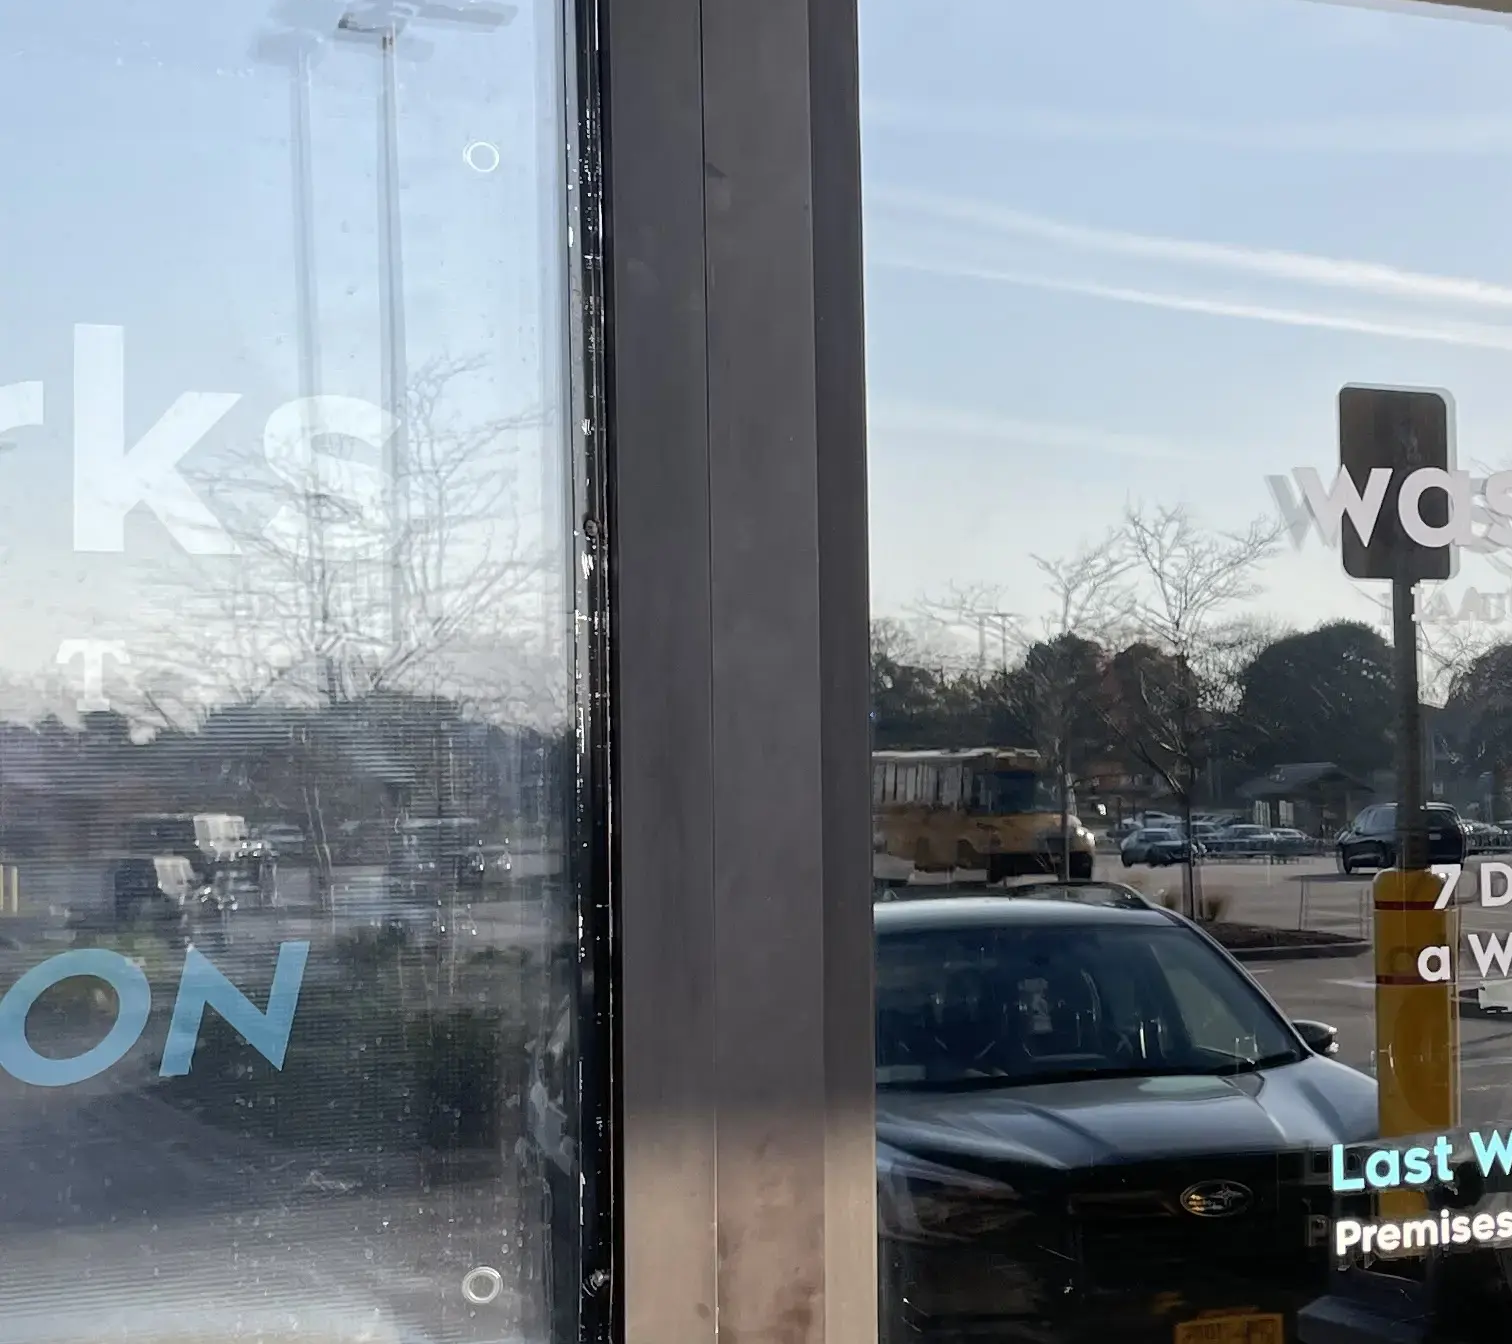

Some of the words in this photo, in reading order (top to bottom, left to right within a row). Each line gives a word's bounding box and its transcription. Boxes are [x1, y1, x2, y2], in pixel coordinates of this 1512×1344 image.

[1431, 863, 1461, 910] 7
[1417, 945, 1451, 982] a
[1331, 1135, 1455, 1192] Last
